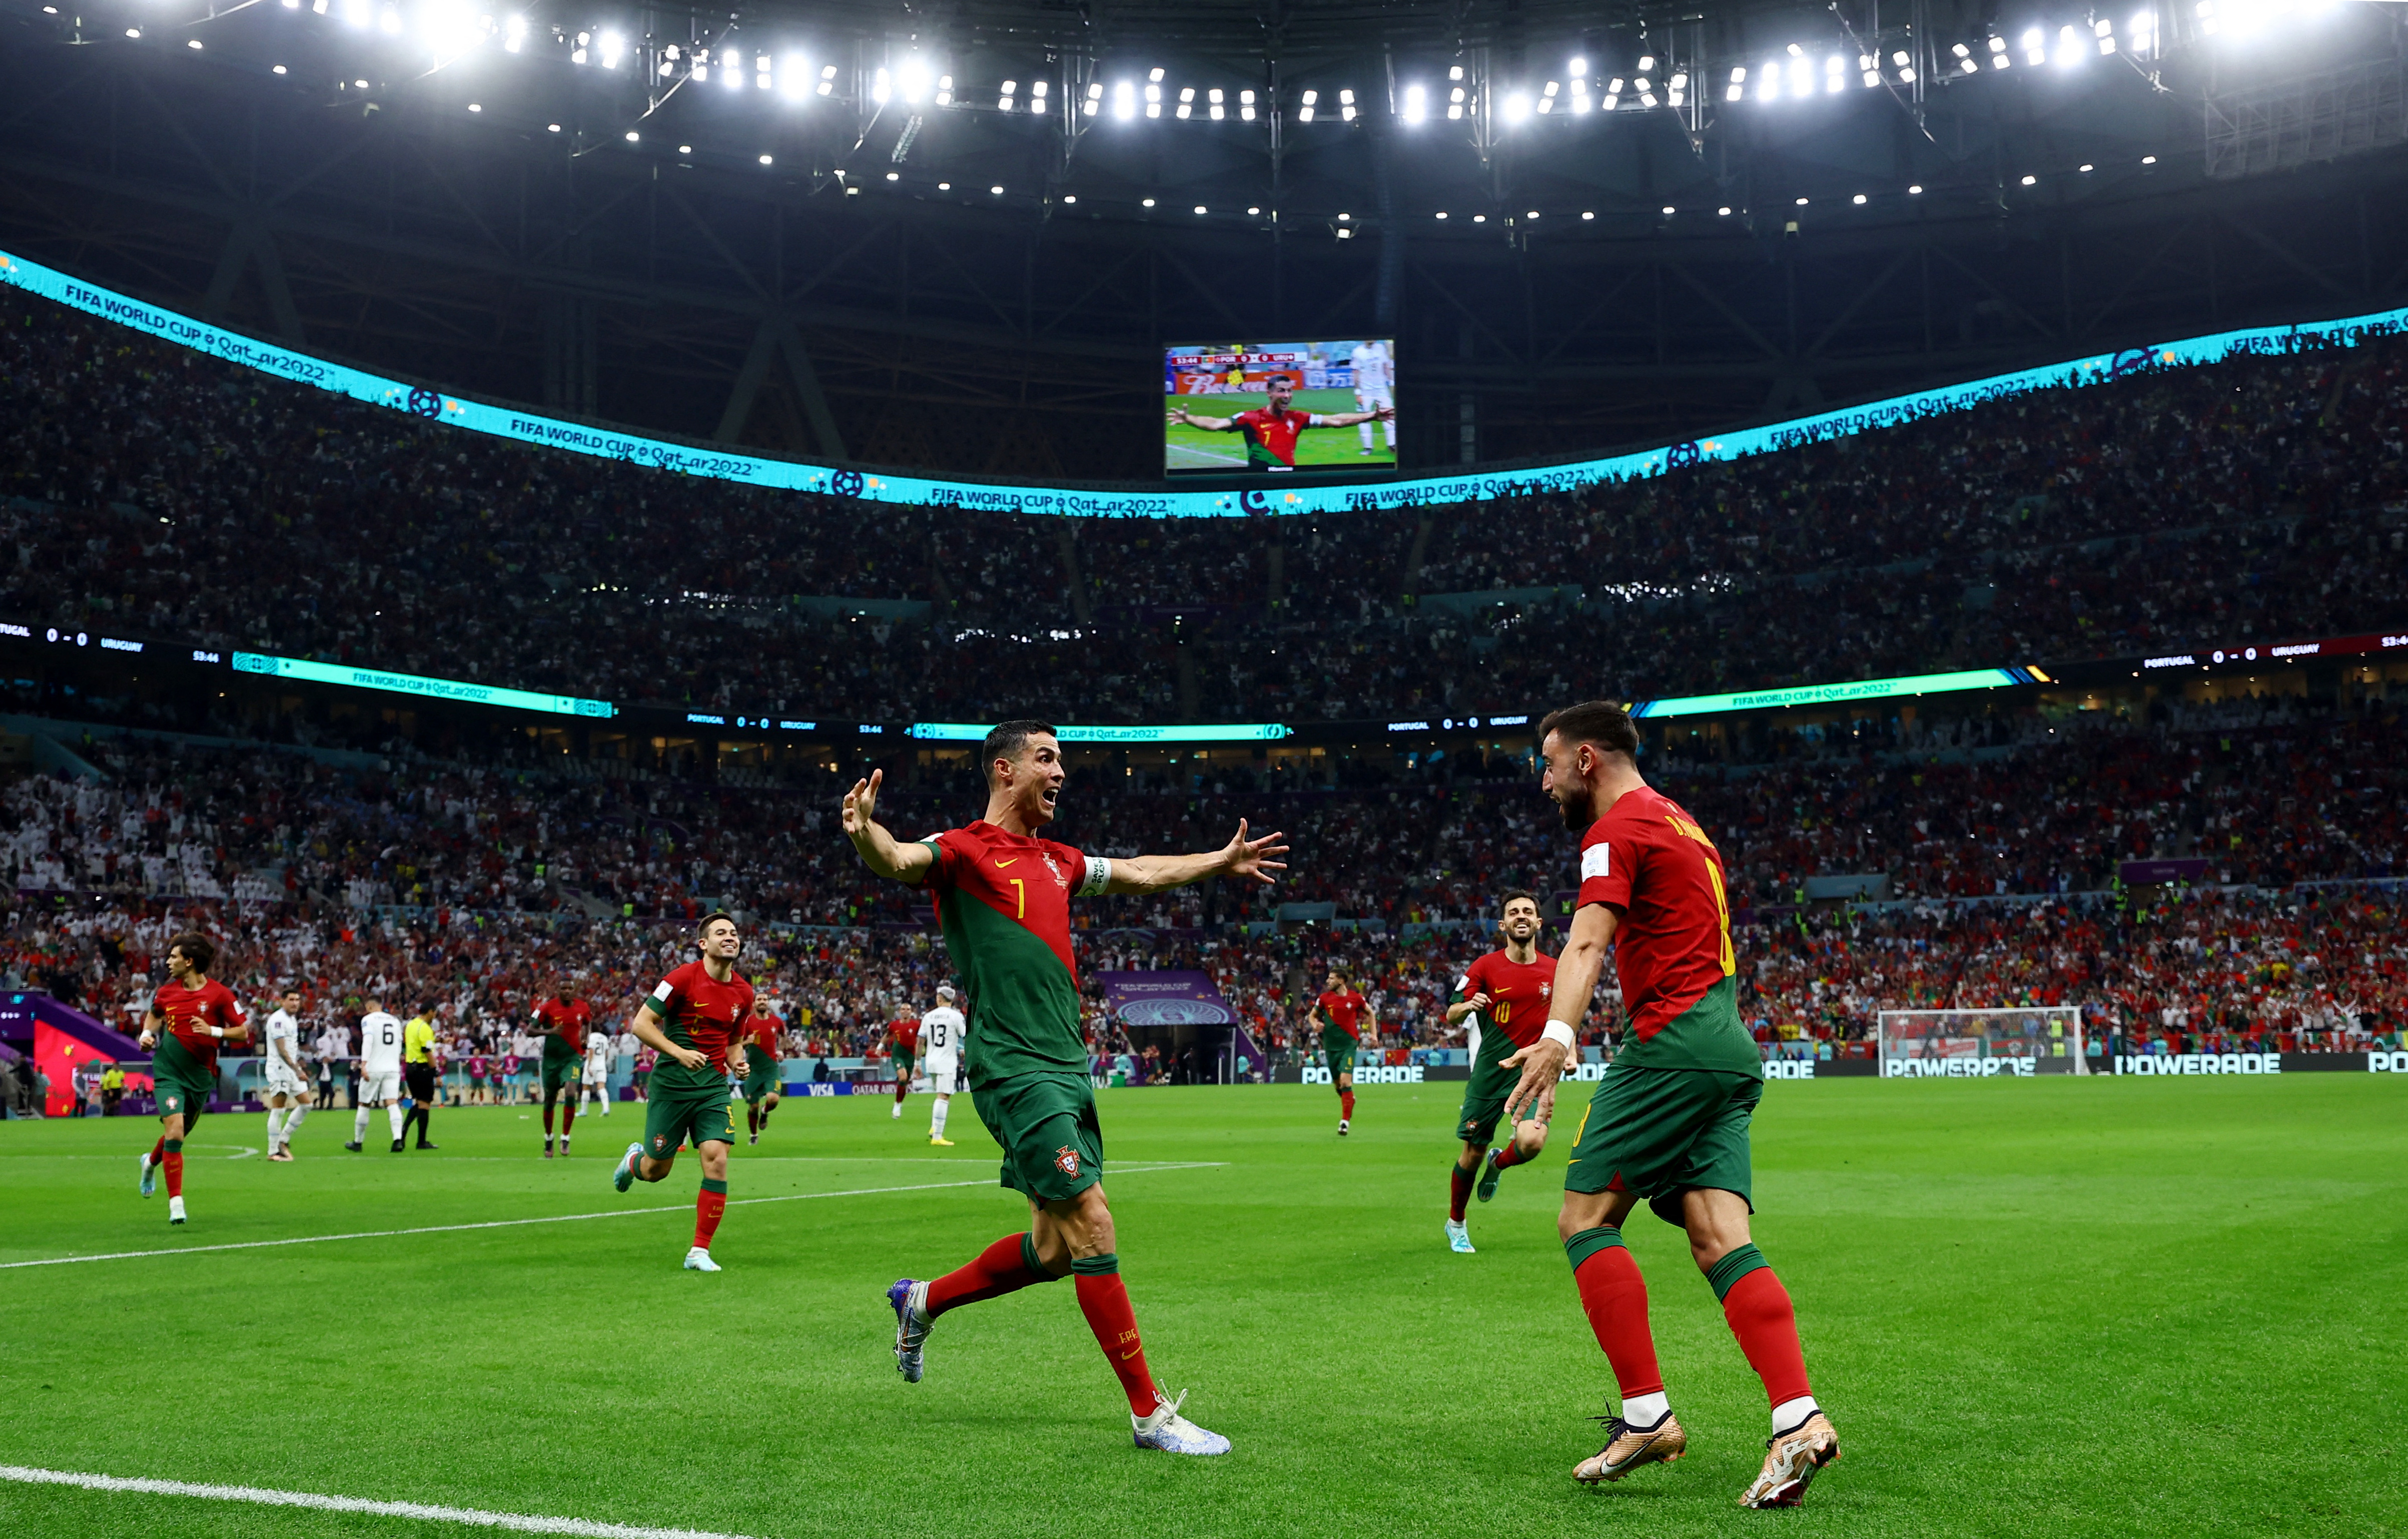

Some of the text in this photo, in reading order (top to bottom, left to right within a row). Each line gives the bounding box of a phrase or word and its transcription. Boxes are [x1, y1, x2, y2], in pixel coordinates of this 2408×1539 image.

[66, 285, 101, 307] FIFA
[104, 298, 166, 328] WORLD
[169, 321, 201, 340] CUP
[1771, 427, 1804, 444] FIFA
[1807, 414, 1865, 434] WORLD
[1869, 406, 1900, 424] CUP
[511, 419, 544, 437] FIFA
[547, 428, 603, 448] WORLD
[606, 440, 635, 454] CUP
[932, 488, 964, 502] FIFA
[966, 491, 1021, 506] WORLD
[1024, 495, 1053, 507] CUP
[1346, 492, 1377, 505] FIFA
[1380, 487, 1435, 503] WORLD
[1439, 483, 1468, 497] CUP
[46, 628, 58, 642] 0
[76, 632, 88, 646] 0
[100, 637, 144, 652] URUGUAY
[2382, 635, 2408, 647] 53:4
[193, 650, 220, 663] 53:44
[2144, 655, 2195, 669] PORTUGAL
[2213, 651, 2224, 664] 0
[2245, 648, 2257, 660] 0
[2272, 643, 2320, 657] URUGUAY
[353, 673, 372, 683] FIFA
[374, 676, 406, 688] WORLD
[408, 680, 425, 690] CUP
[1733, 697, 1754, 706] FIFA
[1755, 693, 1792, 705] WORLD
[1793, 690, 1813, 701] CUP
[687, 714, 725, 725] PORTUGAL
[737, 716, 746, 728] 0
[760, 718, 770, 729] 0
[780, 721, 816, 730] URUGUAY
[858, 725, 883, 734] 53:44
[1388, 721, 1429, 731] PORTUGAL
[1443, 718, 1453, 730] 0
[1469, 717, 1478, 728] 0
[1490, 716, 1528, 726] URUGUAY
[1009, 878, 1024, 919] 7
[1495, 1001, 1510, 1023] 10
[383, 1023, 394, 1045] 6
[691, 1014, 704, 1034] 5
[930, 1024, 946, 1047] 13
[595, 1042, 604, 1055] 21
[2115, 1053, 2282, 1075] POWERADE
[1302, 1065, 1425, 1085] POERADE
[807, 1083, 834, 1096] VISA
[852, 1084, 879, 1095] QATAR
